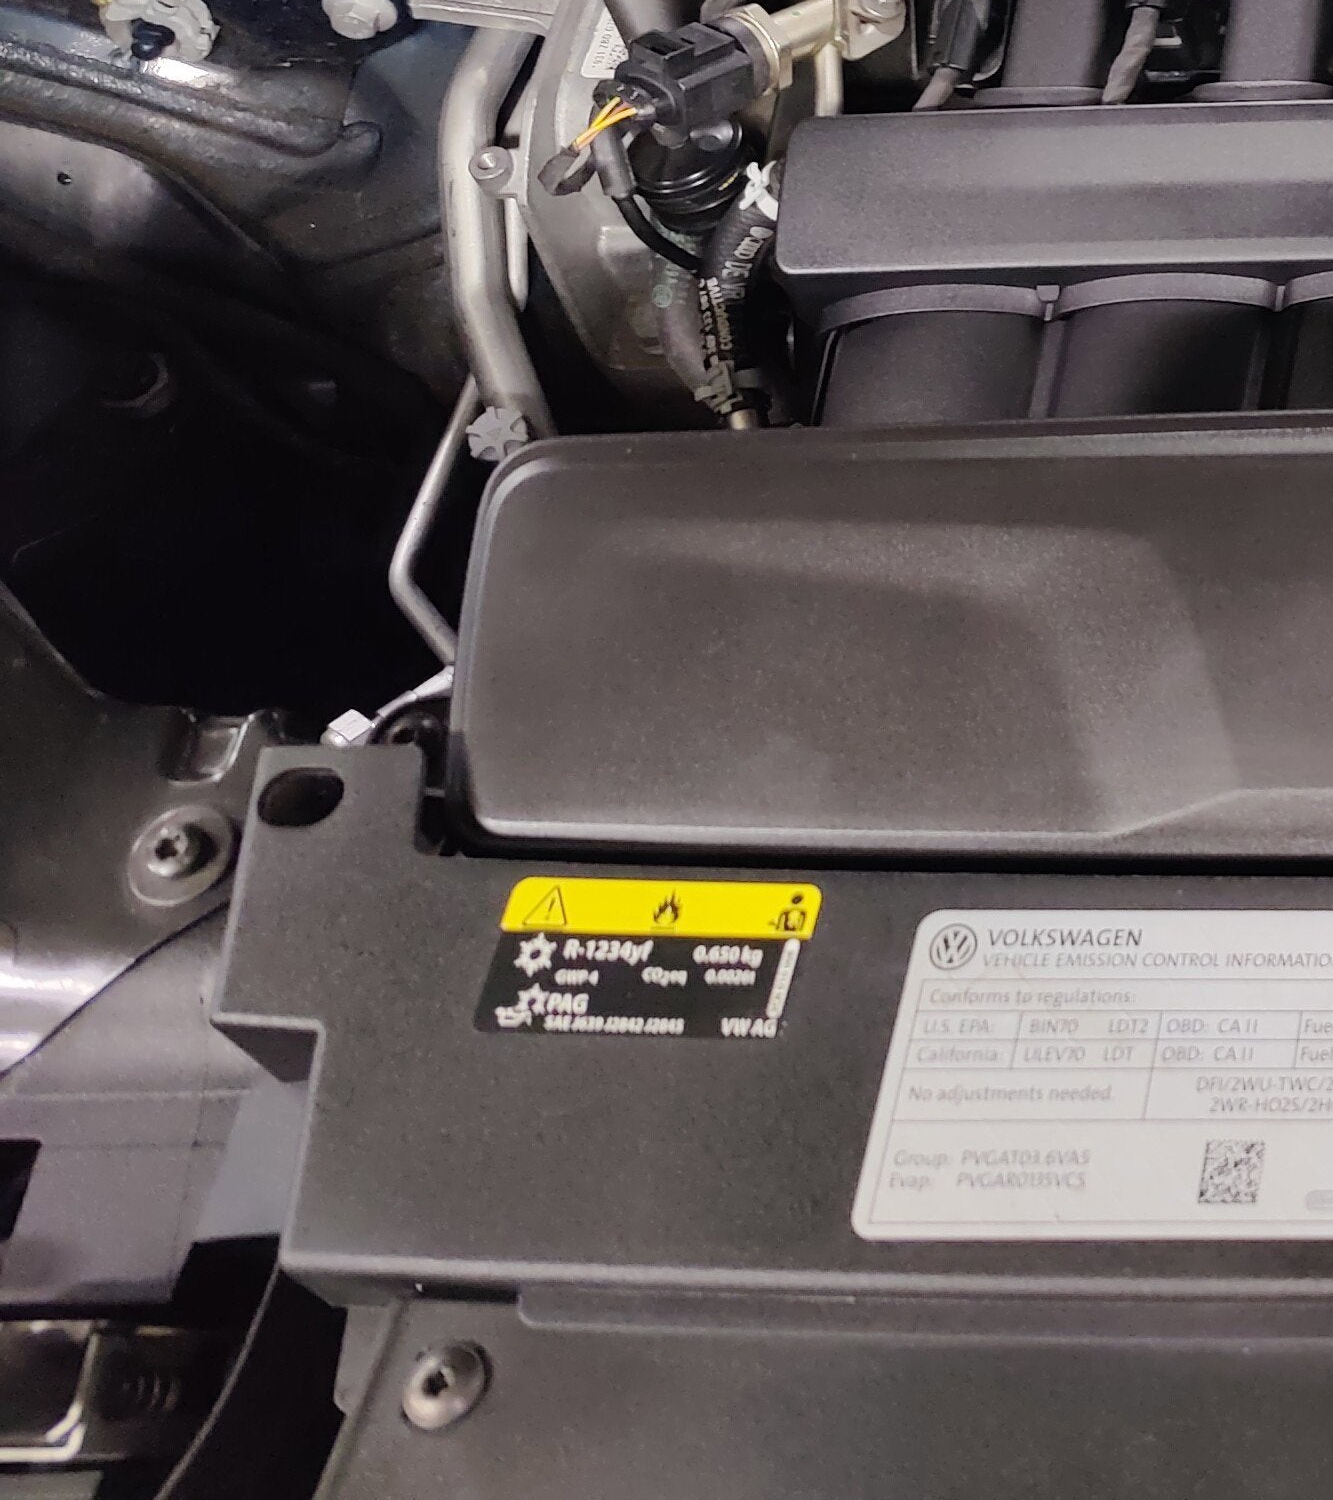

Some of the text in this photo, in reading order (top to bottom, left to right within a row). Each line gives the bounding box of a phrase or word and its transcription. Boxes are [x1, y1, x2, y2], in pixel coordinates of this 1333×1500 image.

[988, 928, 1143, 947] VOLKSWAGEN
[983, 952, 1050, 968] VEHICLE
[1055, 952, 1138, 968] EMISSION
[1142, 952, 1220, 968] CONTROL
[930, 987, 1010, 1004] Conforms
[1015, 988, 1034, 1004] to
[1108, 1018, 1150, 1034] LDT2
[1102, 1046, 1134, 1062] LDT
[909, 1085, 933, 1102] No
[936, 1085, 1044, 1106] adjustments
